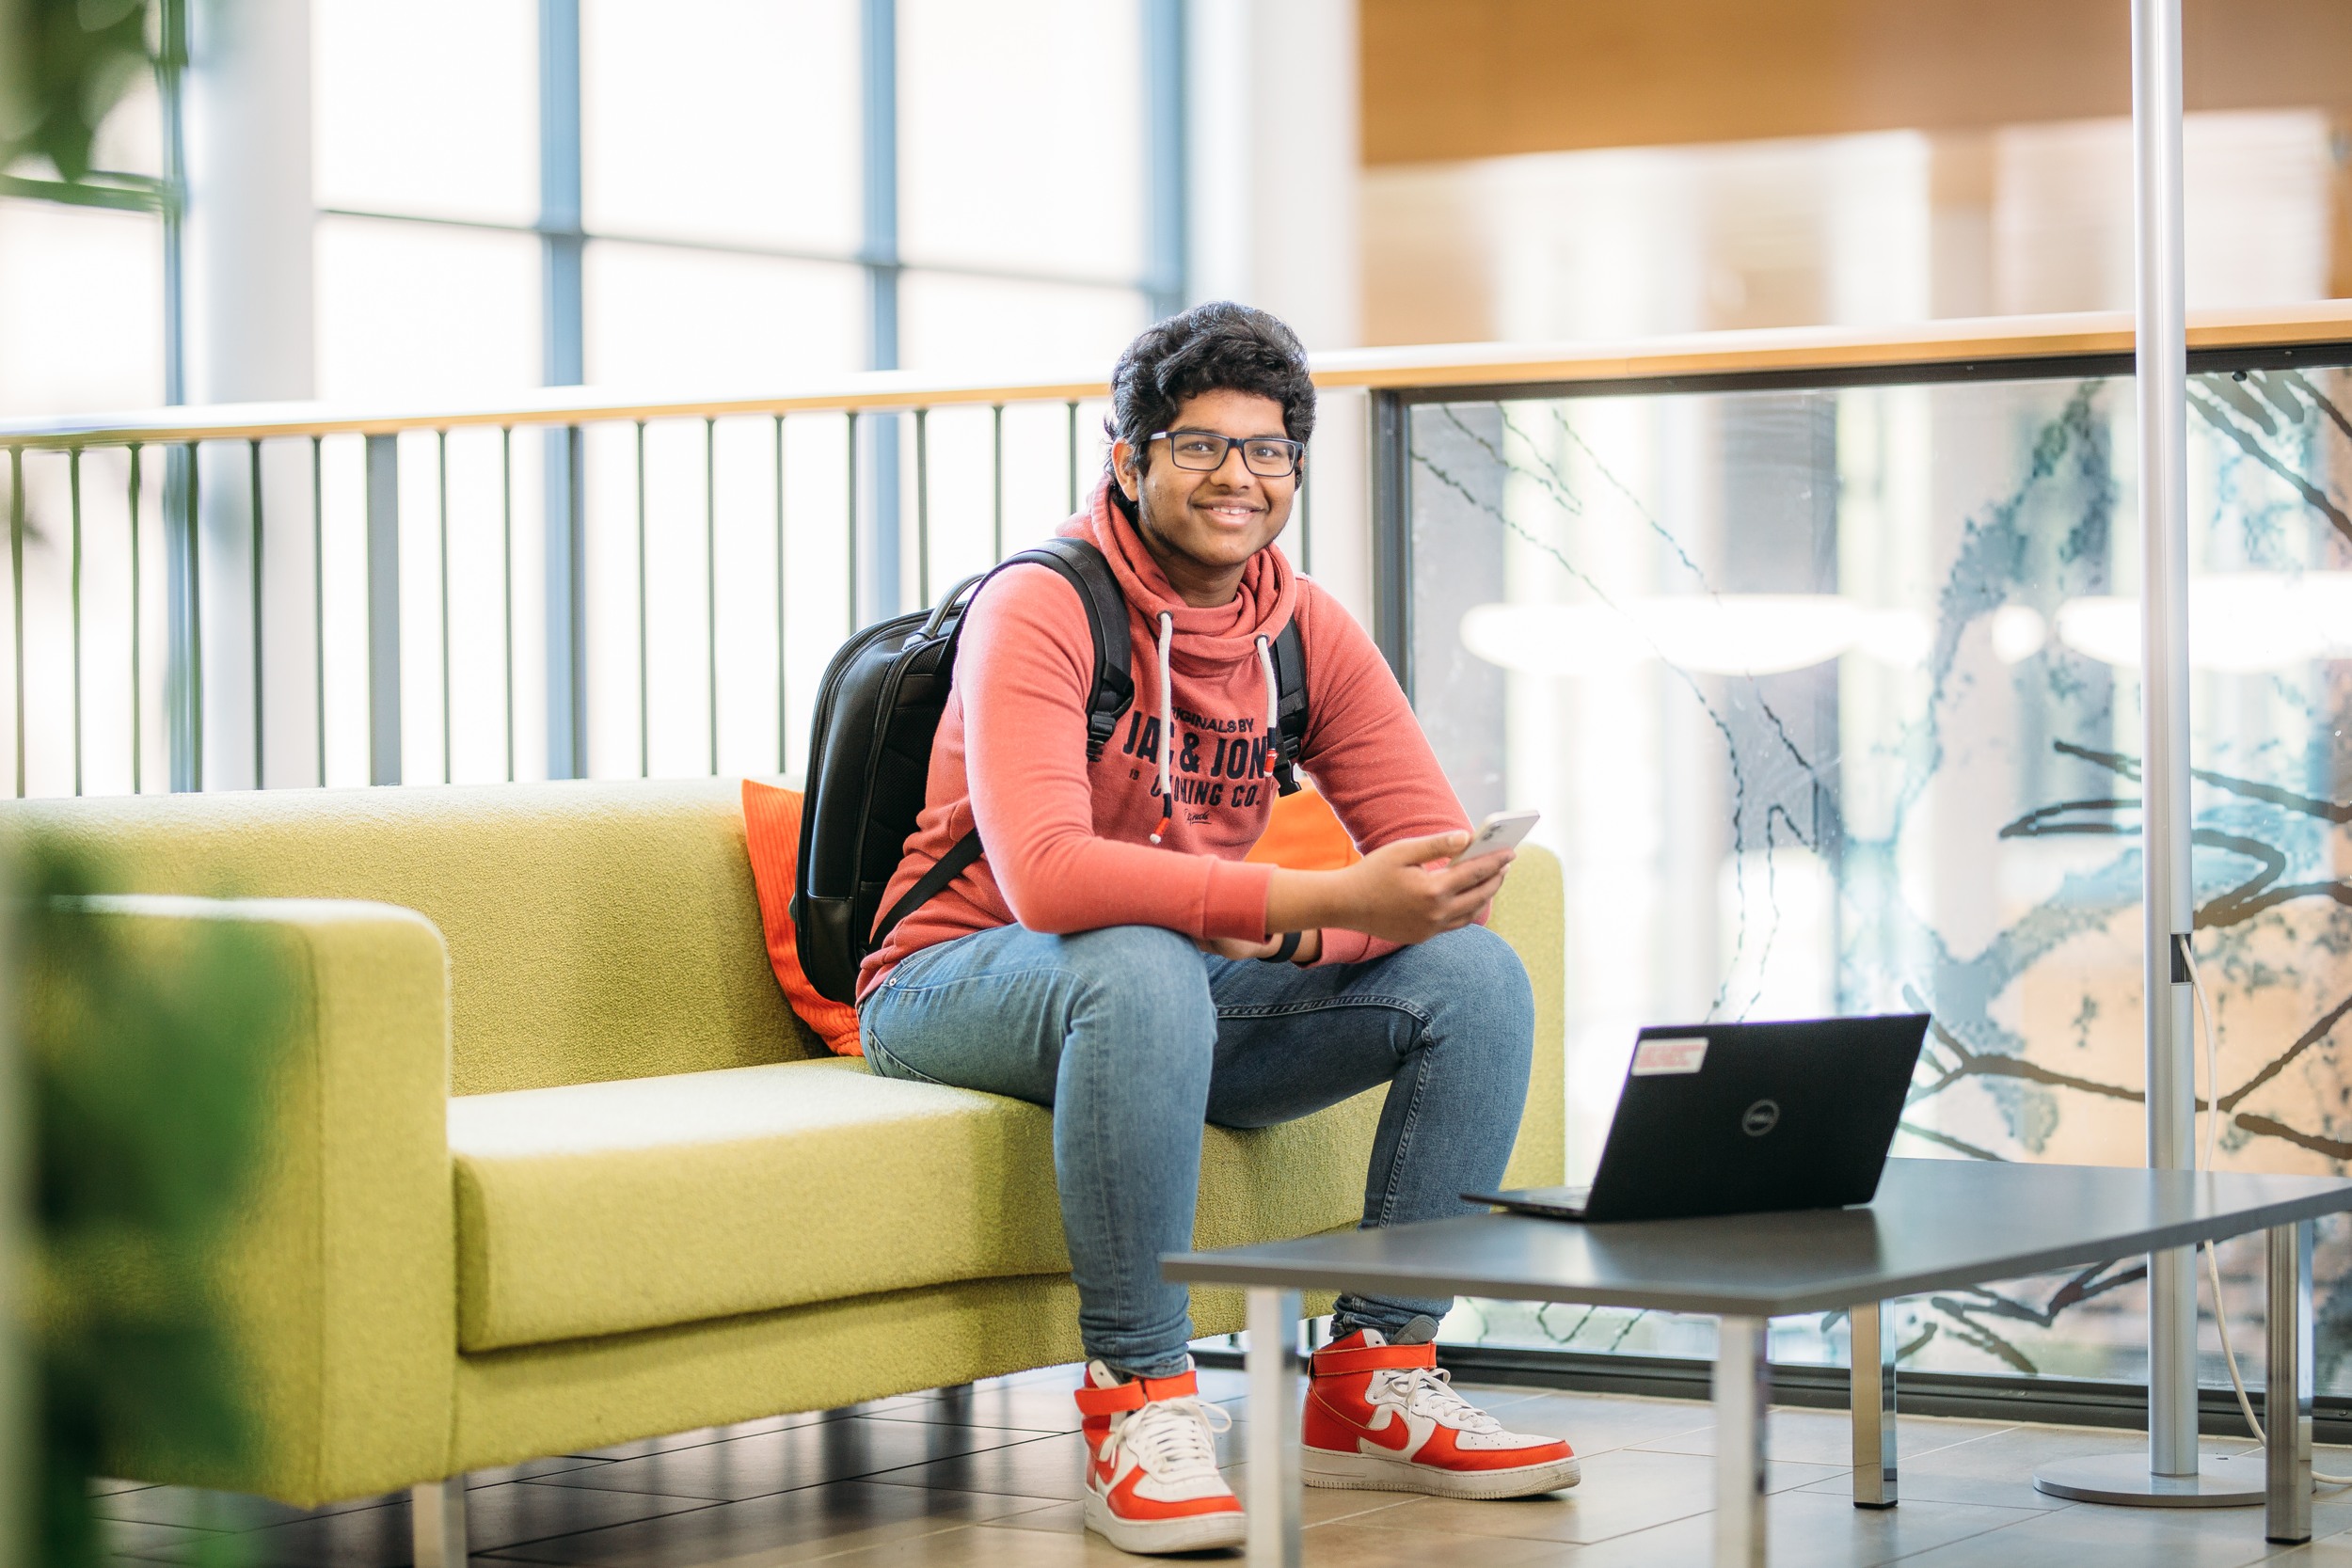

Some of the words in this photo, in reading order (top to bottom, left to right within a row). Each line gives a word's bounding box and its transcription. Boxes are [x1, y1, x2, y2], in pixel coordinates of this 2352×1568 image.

[1171, 706, 1237, 733] RIGINALS
[1237, 718, 1254, 733] BY
[1180, 732, 1200, 773] &
[1231, 783, 1261, 808] CO.
